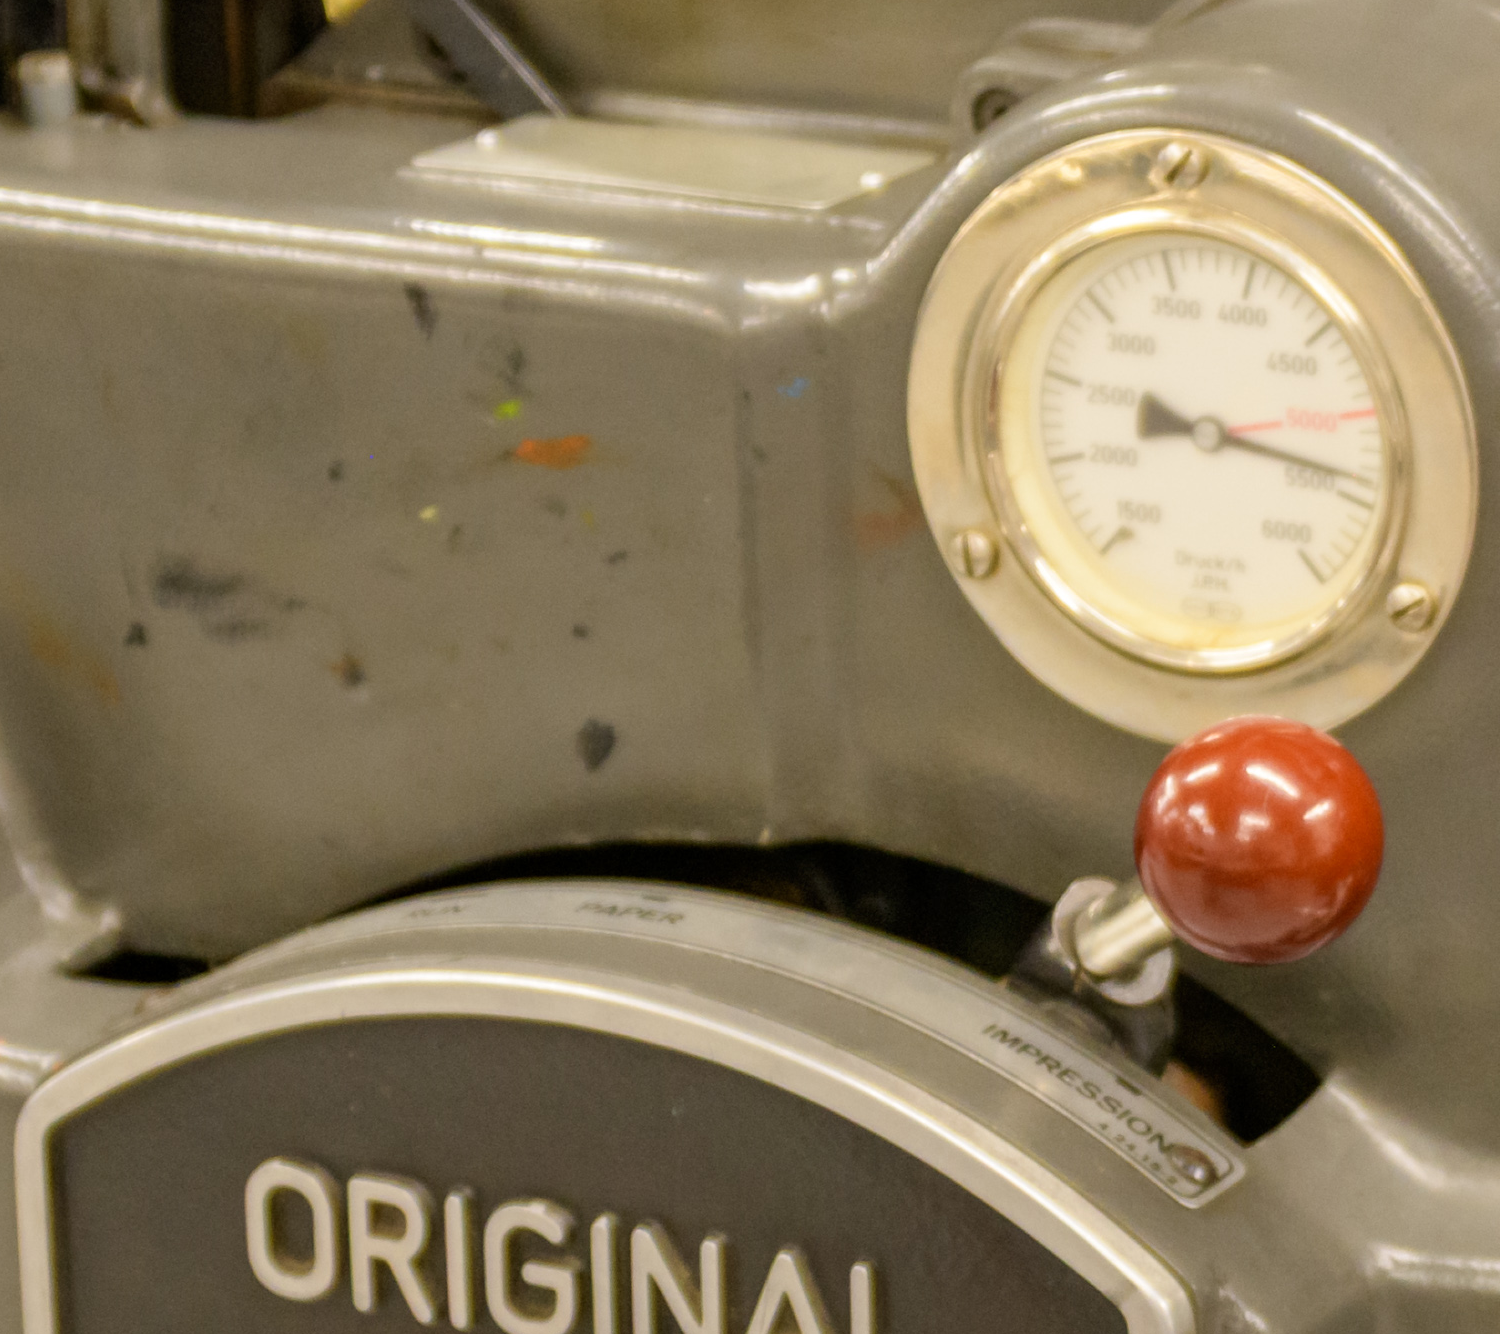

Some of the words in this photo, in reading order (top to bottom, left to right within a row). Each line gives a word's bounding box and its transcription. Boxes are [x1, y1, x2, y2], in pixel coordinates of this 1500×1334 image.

[1152, 295, 1199, 321] 3500
[1217, 306, 1268, 328] 4000
[1107, 332, 1156, 357] 3000
[1266, 351, 1318, 377] 4500
[1086, 383, 1137, 408] 2500
[1089, 444, 1138, 467] 2000
[1116, 500, 1162, 524] 1500
[1261, 519, 1312, 544] 6000
[980, 1022, 1176, 1155] IMPRESSION
